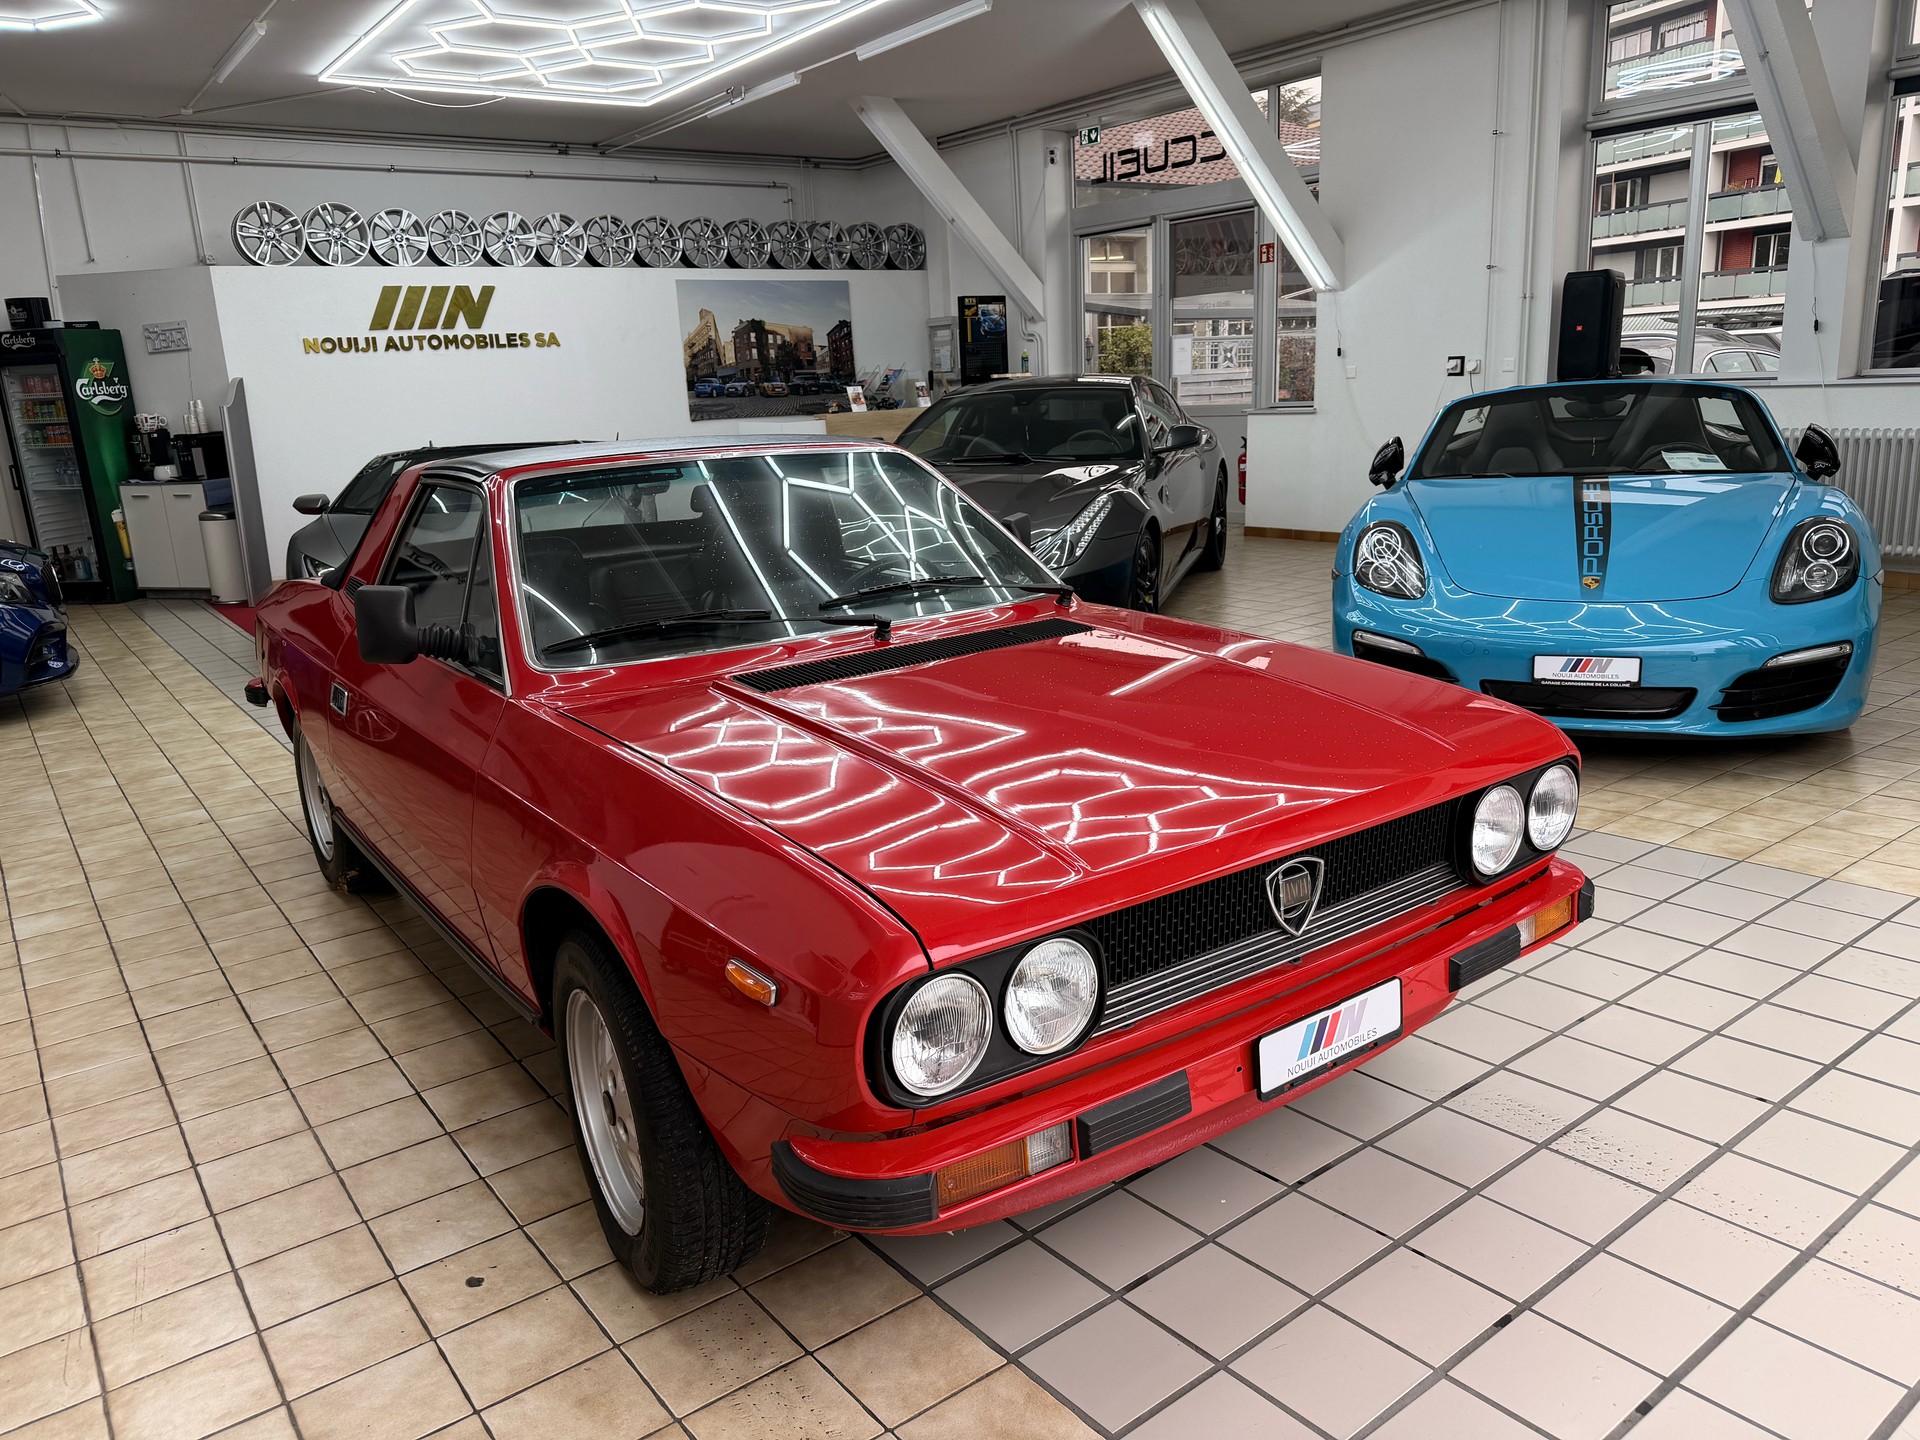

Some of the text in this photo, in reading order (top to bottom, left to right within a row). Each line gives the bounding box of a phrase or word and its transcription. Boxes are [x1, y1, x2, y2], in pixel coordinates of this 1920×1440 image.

[1, 333, 36, 350] Carlsberg
[303, 331, 560, 354] NOUIJI AUTOMOBILES SA
[75, 378, 128, 403] Carlsberg
[1582, 483, 1604, 575] PORSCHE
[1287, 1027, 1378, 1078] NOUIJI AUTOMOBILES
